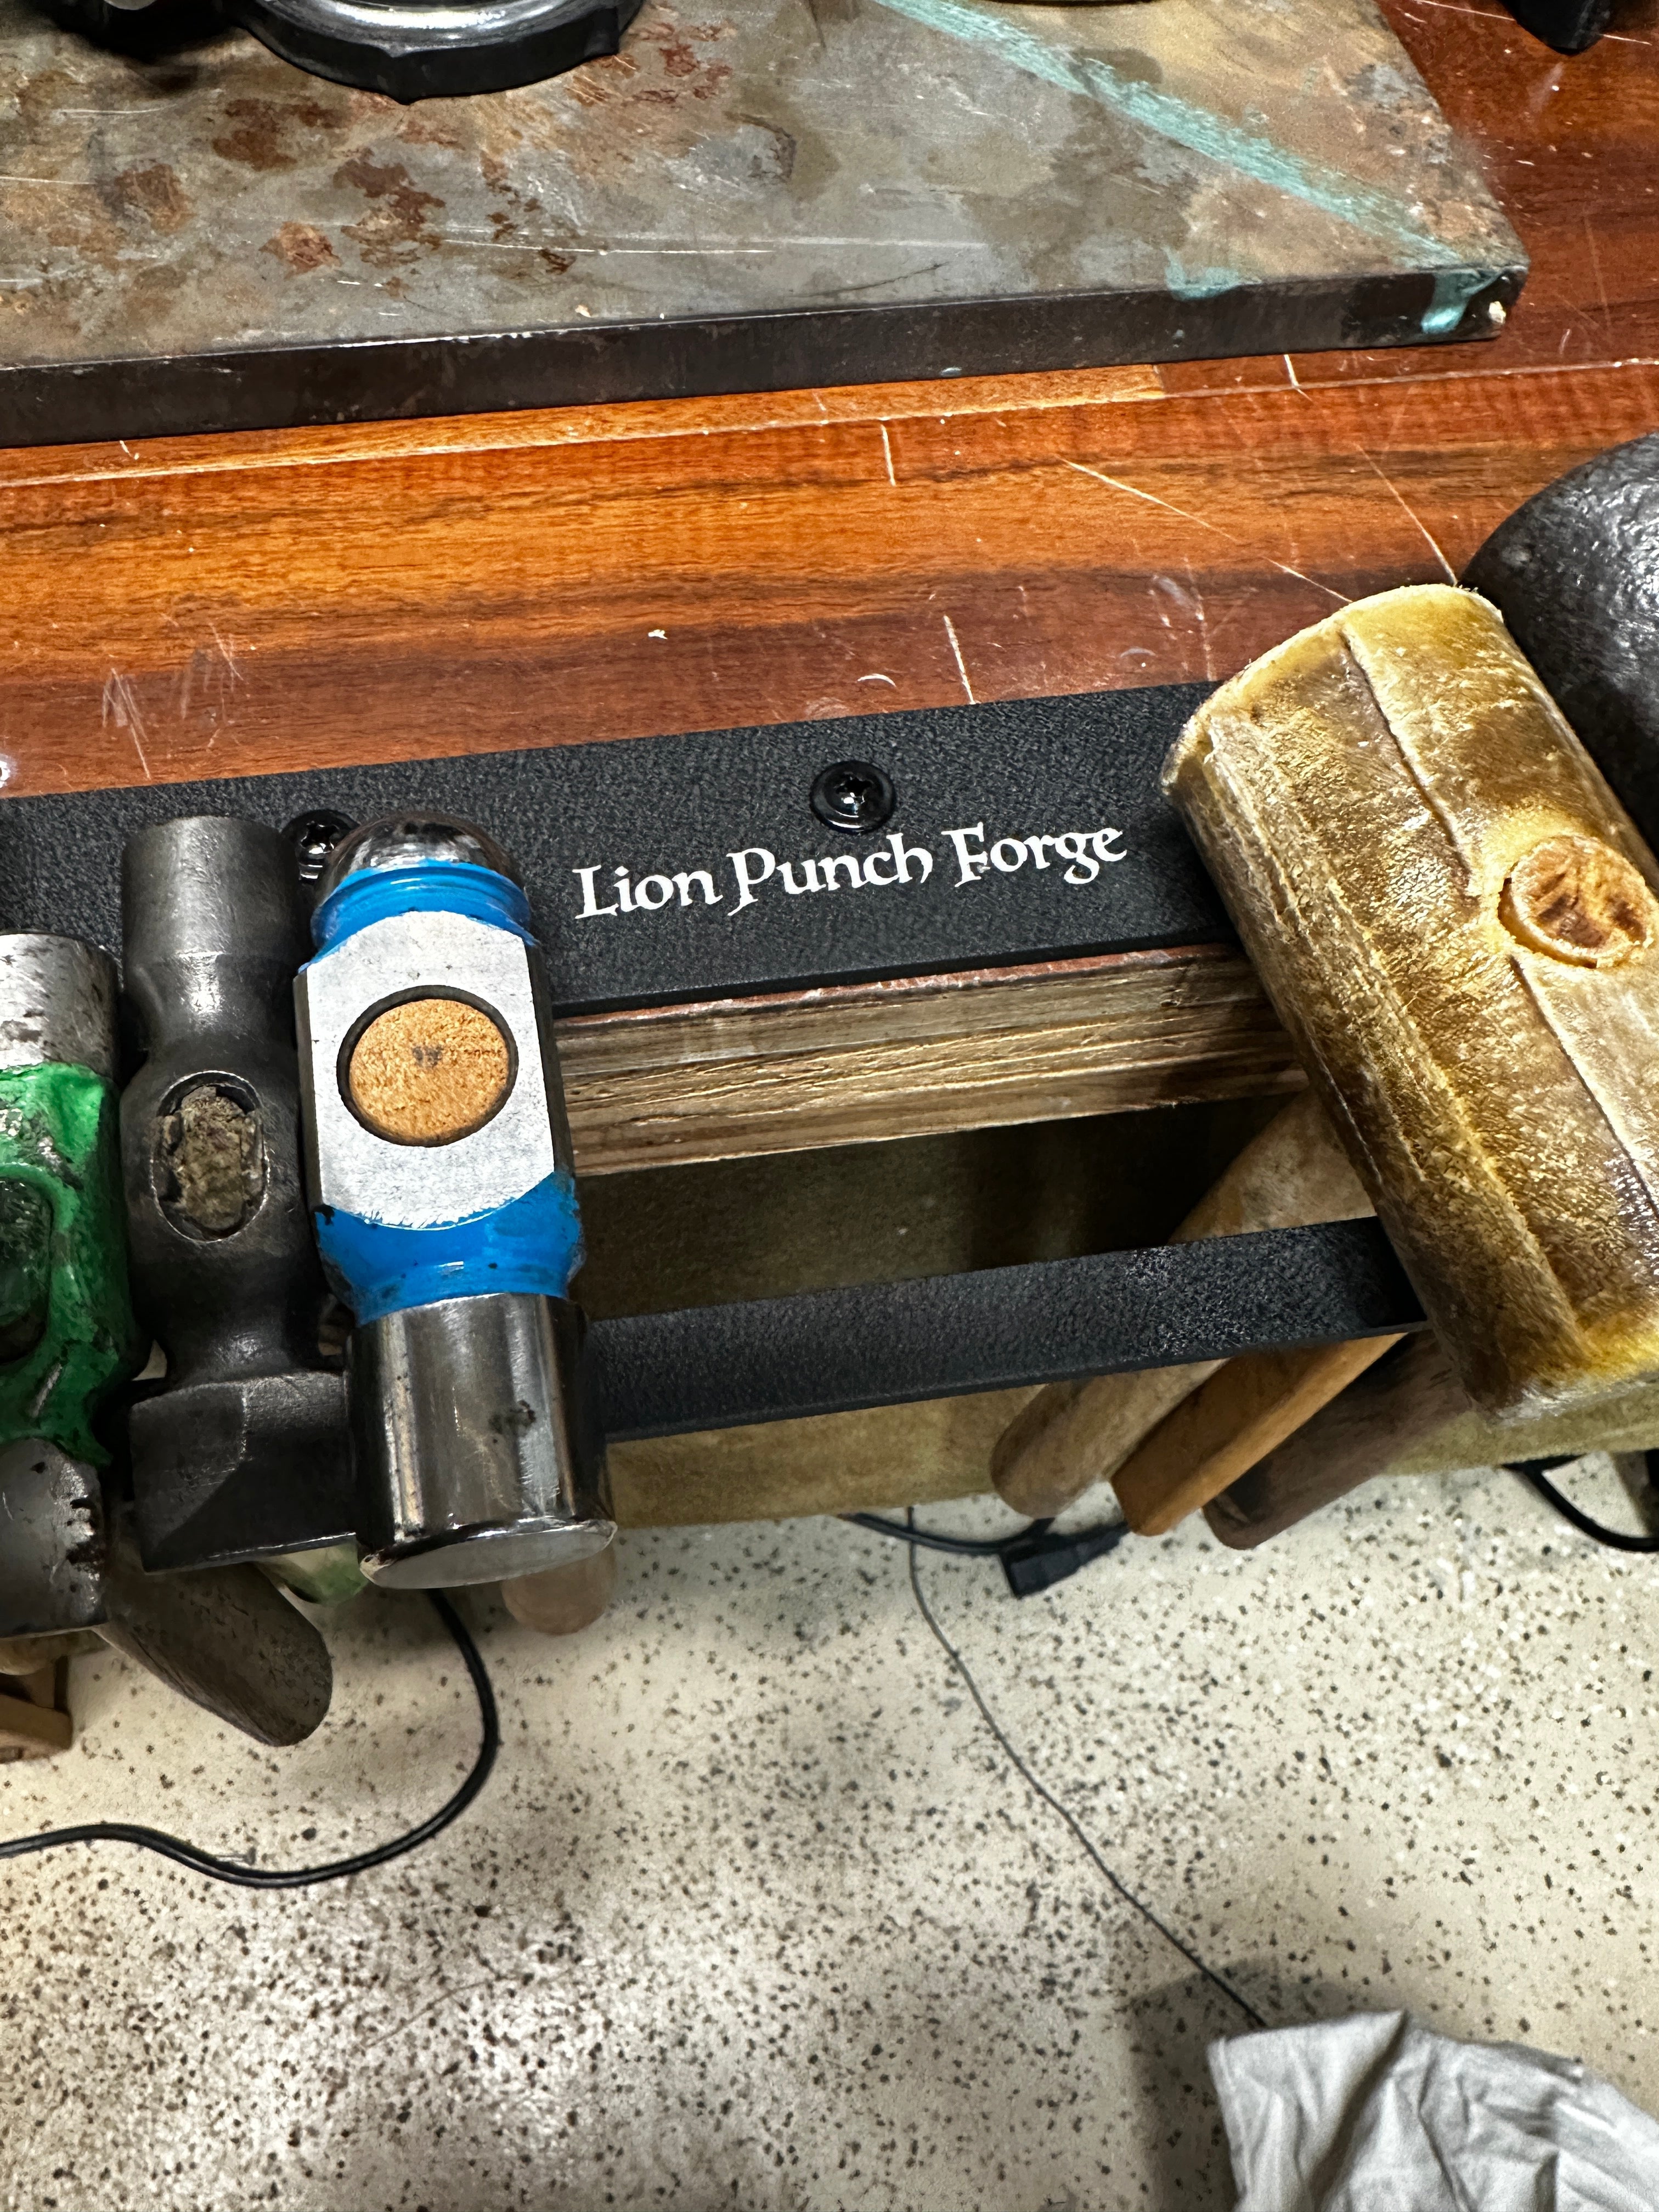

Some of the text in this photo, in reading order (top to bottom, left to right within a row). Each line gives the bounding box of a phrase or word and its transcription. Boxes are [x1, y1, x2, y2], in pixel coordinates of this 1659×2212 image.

[572, 821, 1127, 919] Lion Punch Forge
